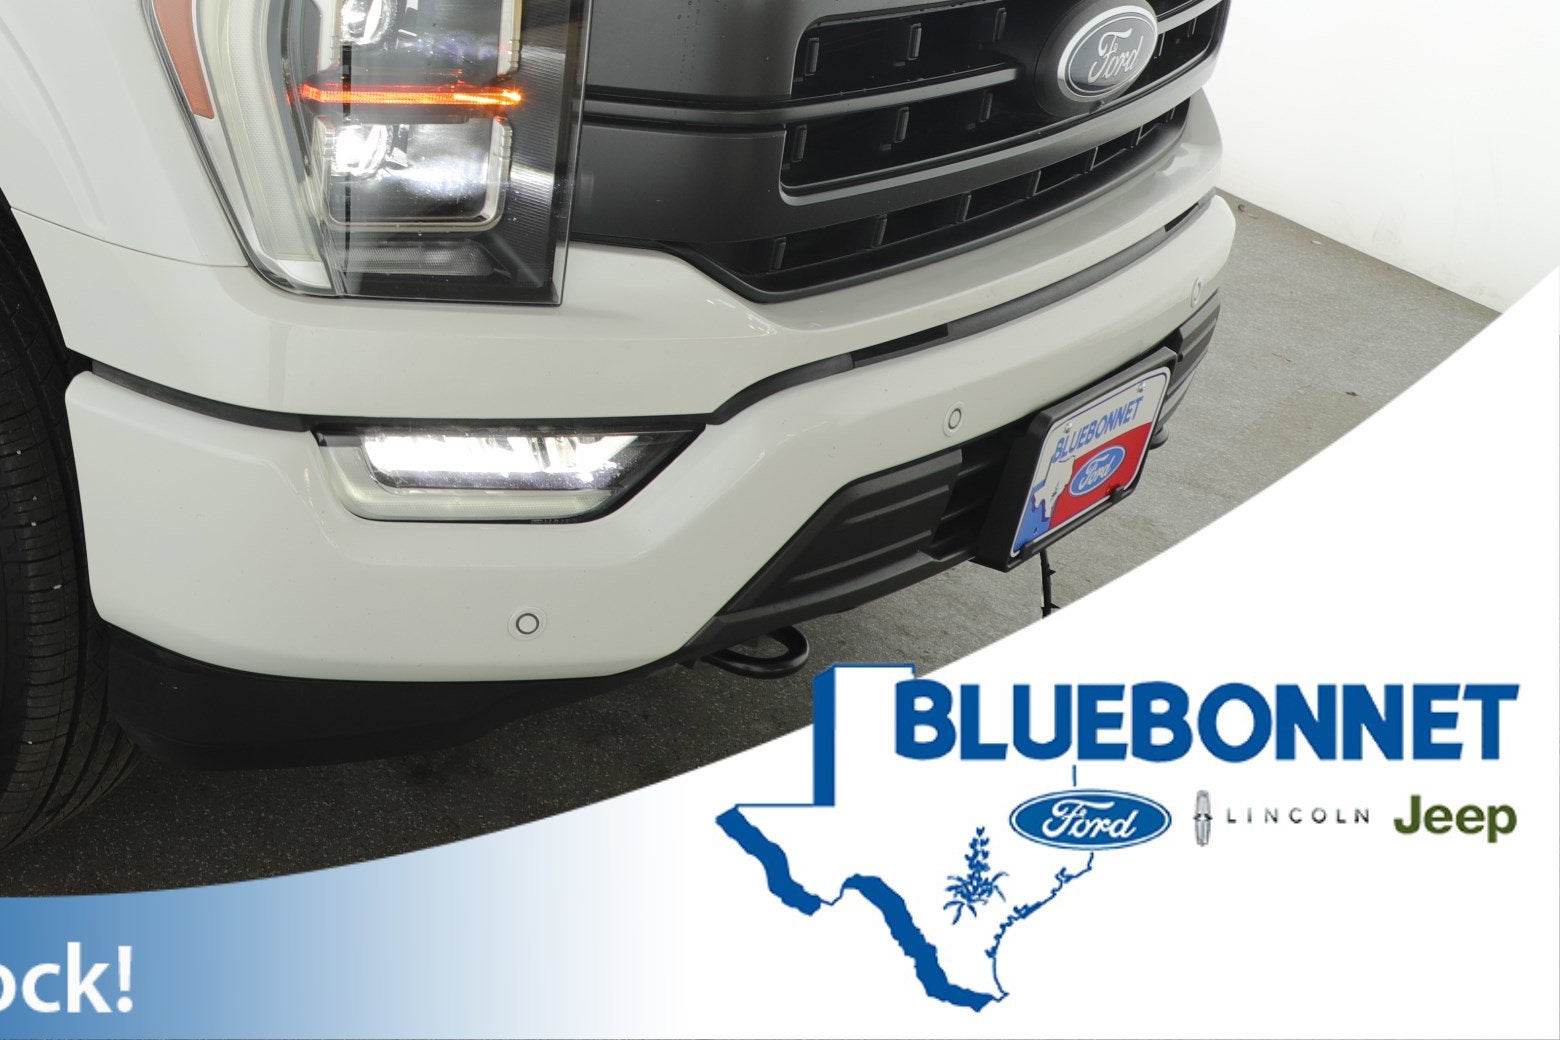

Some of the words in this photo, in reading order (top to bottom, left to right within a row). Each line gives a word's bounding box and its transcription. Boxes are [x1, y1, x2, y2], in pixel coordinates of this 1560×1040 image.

[1088, 27, 1144, 84] Ford
[1051, 396, 1144, 463] BLUEBONNET
[1079, 454, 1116, 490] Ford
